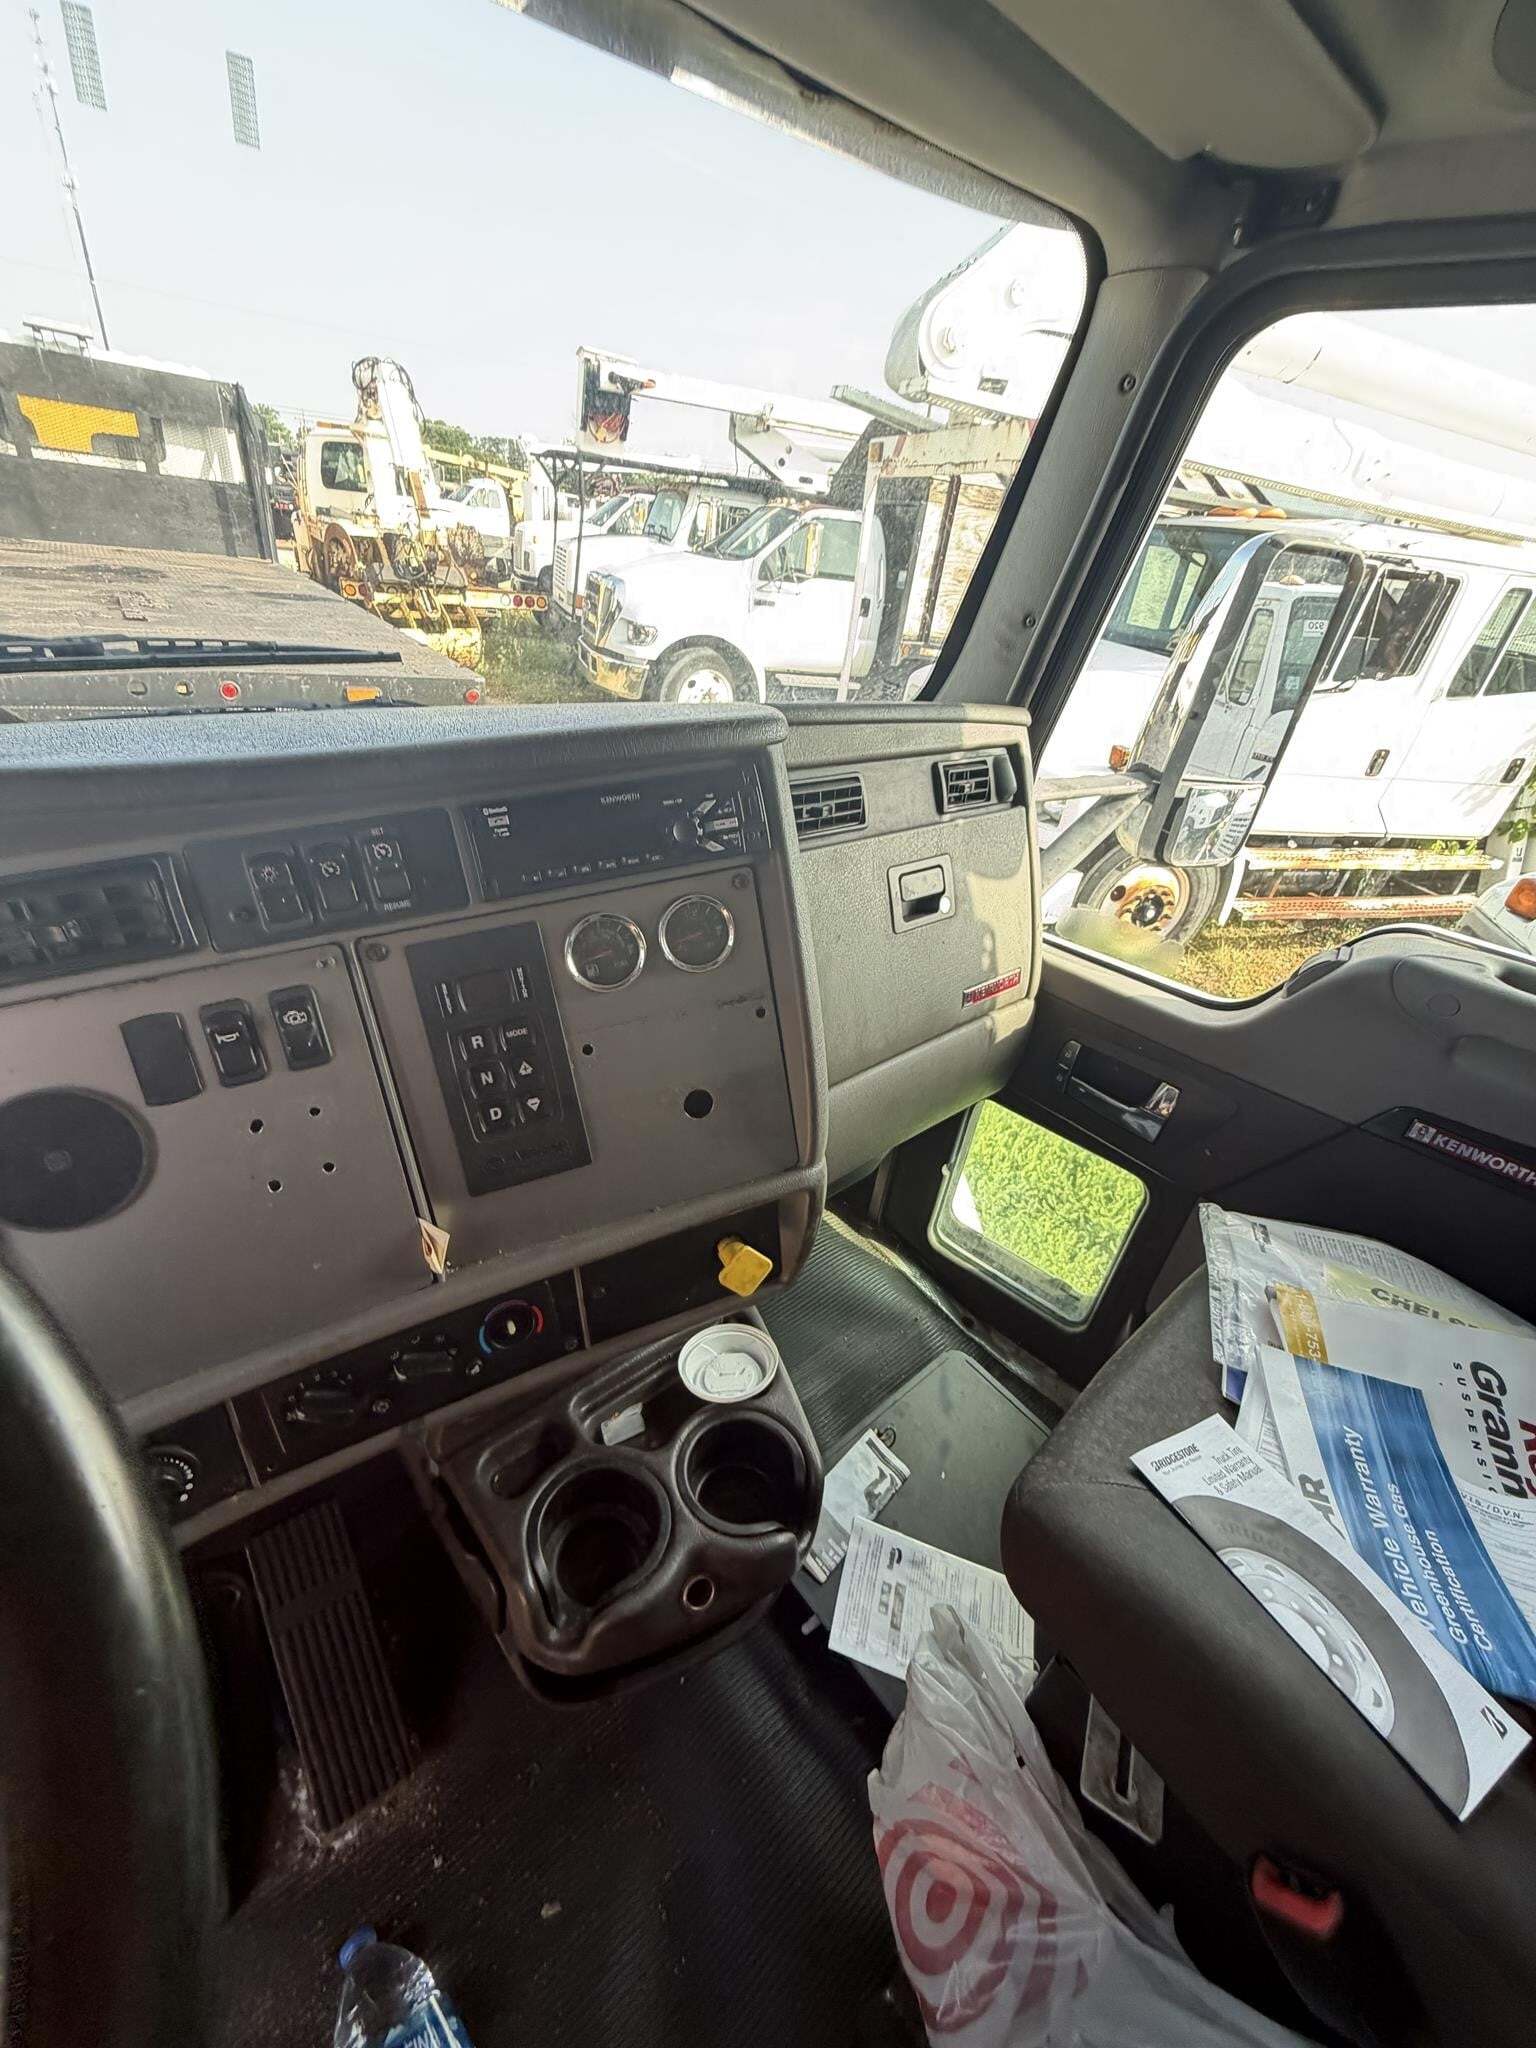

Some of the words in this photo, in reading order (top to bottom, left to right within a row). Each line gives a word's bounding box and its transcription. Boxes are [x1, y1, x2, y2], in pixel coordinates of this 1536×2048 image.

[471, 1035, 484, 1049] R
[506, 1027, 529, 1038] MODE
[480, 1071, 494, 1085] N
[489, 1107, 502, 1121] D
[1433, 1134, 1536, 1186] KENWORTH
[1150, 1443, 1200, 1472] BRIDGESTONE
[1223, 1455, 1254, 1475] Warranty
[1343, 1425, 1388, 1529] Warranty
[1388, 1482, 1409, 1517] Gas
[1384, 1536, 1438, 1633] Vehicle
[1402, 1522, 1469, 1645] Greenhouse
[1425, 1529, 1494, 1652] Certification
